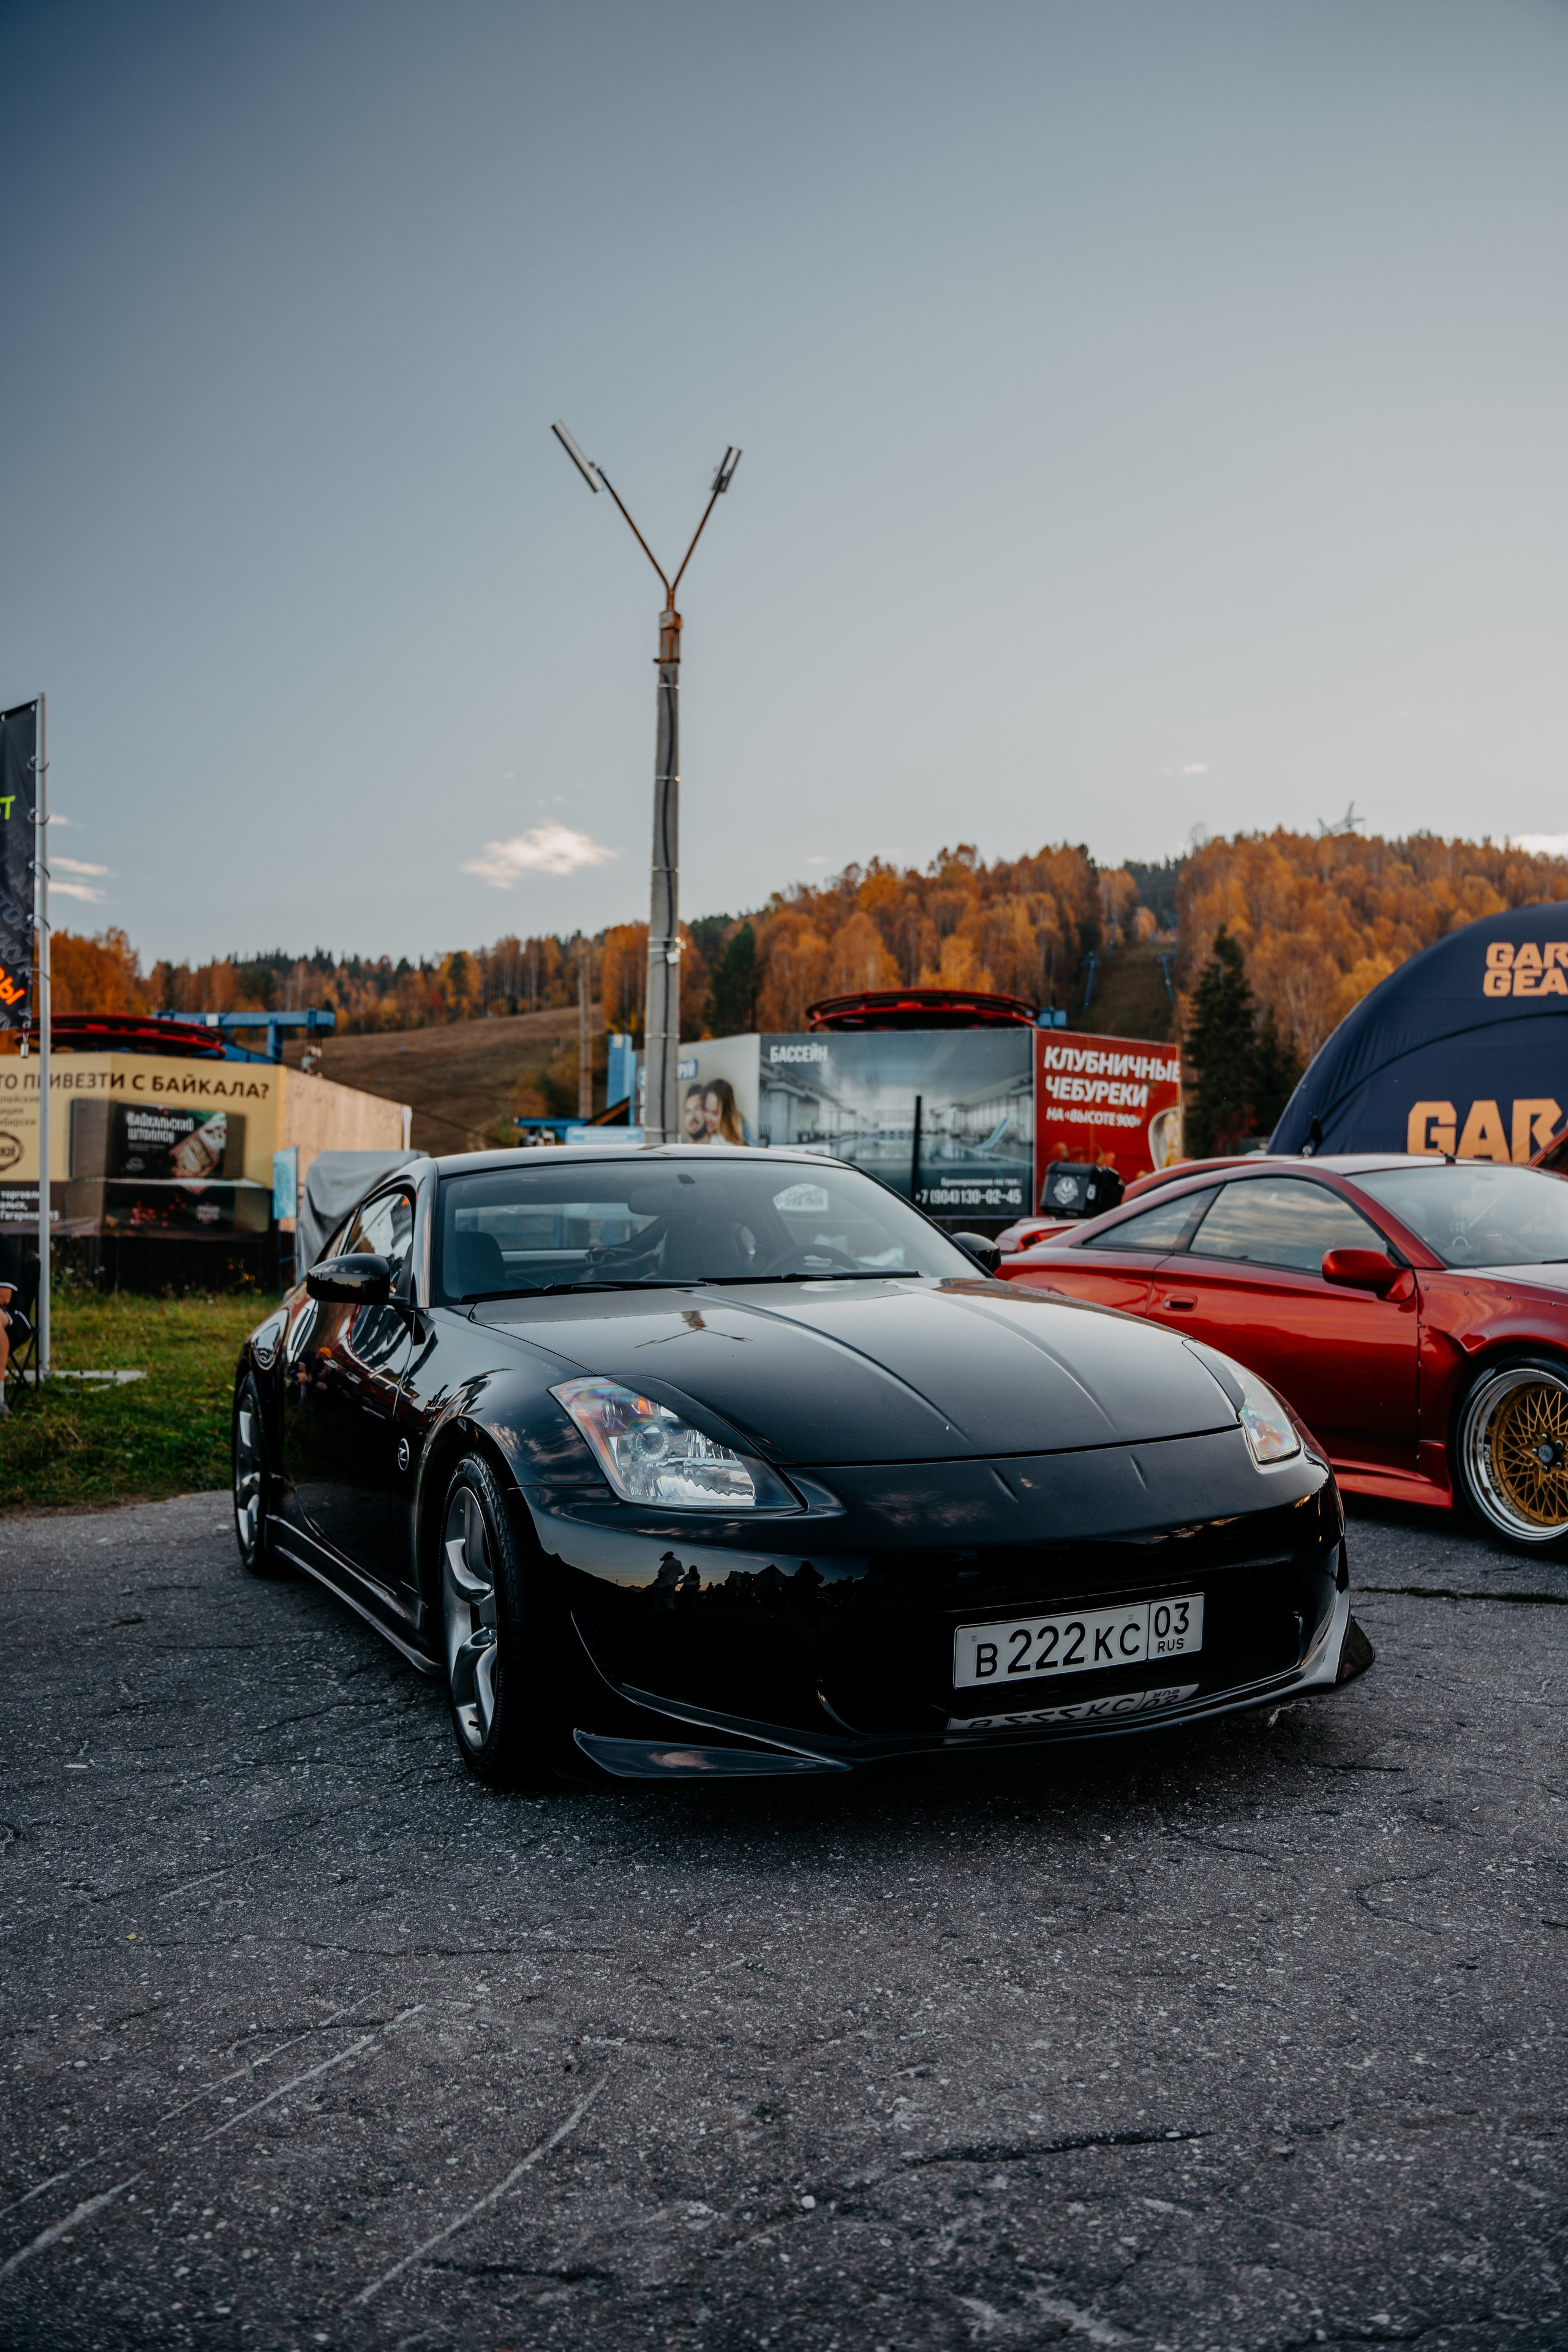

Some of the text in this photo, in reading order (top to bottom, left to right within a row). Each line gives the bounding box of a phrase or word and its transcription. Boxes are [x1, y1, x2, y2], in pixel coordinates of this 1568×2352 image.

[770, 1042, 828, 1063] БАССЕЙН
[1043, 1046, 1181, 1083] КЛУБНИЧНЫЕ
[24, 1072, 125, 1089] ПИВЕЗТИ
[132, 1074, 146, 1091] С
[152, 1073, 270, 1099] БАЙКАЛА?
[1045, 1075, 1149, 1108] ЧЕБУРЕКИ
[1046, 1106, 1065, 1121] НА
[975, 1602, 1190, 1678] В222КС 03
[1158, 1637, 1185, 1653] RUS
